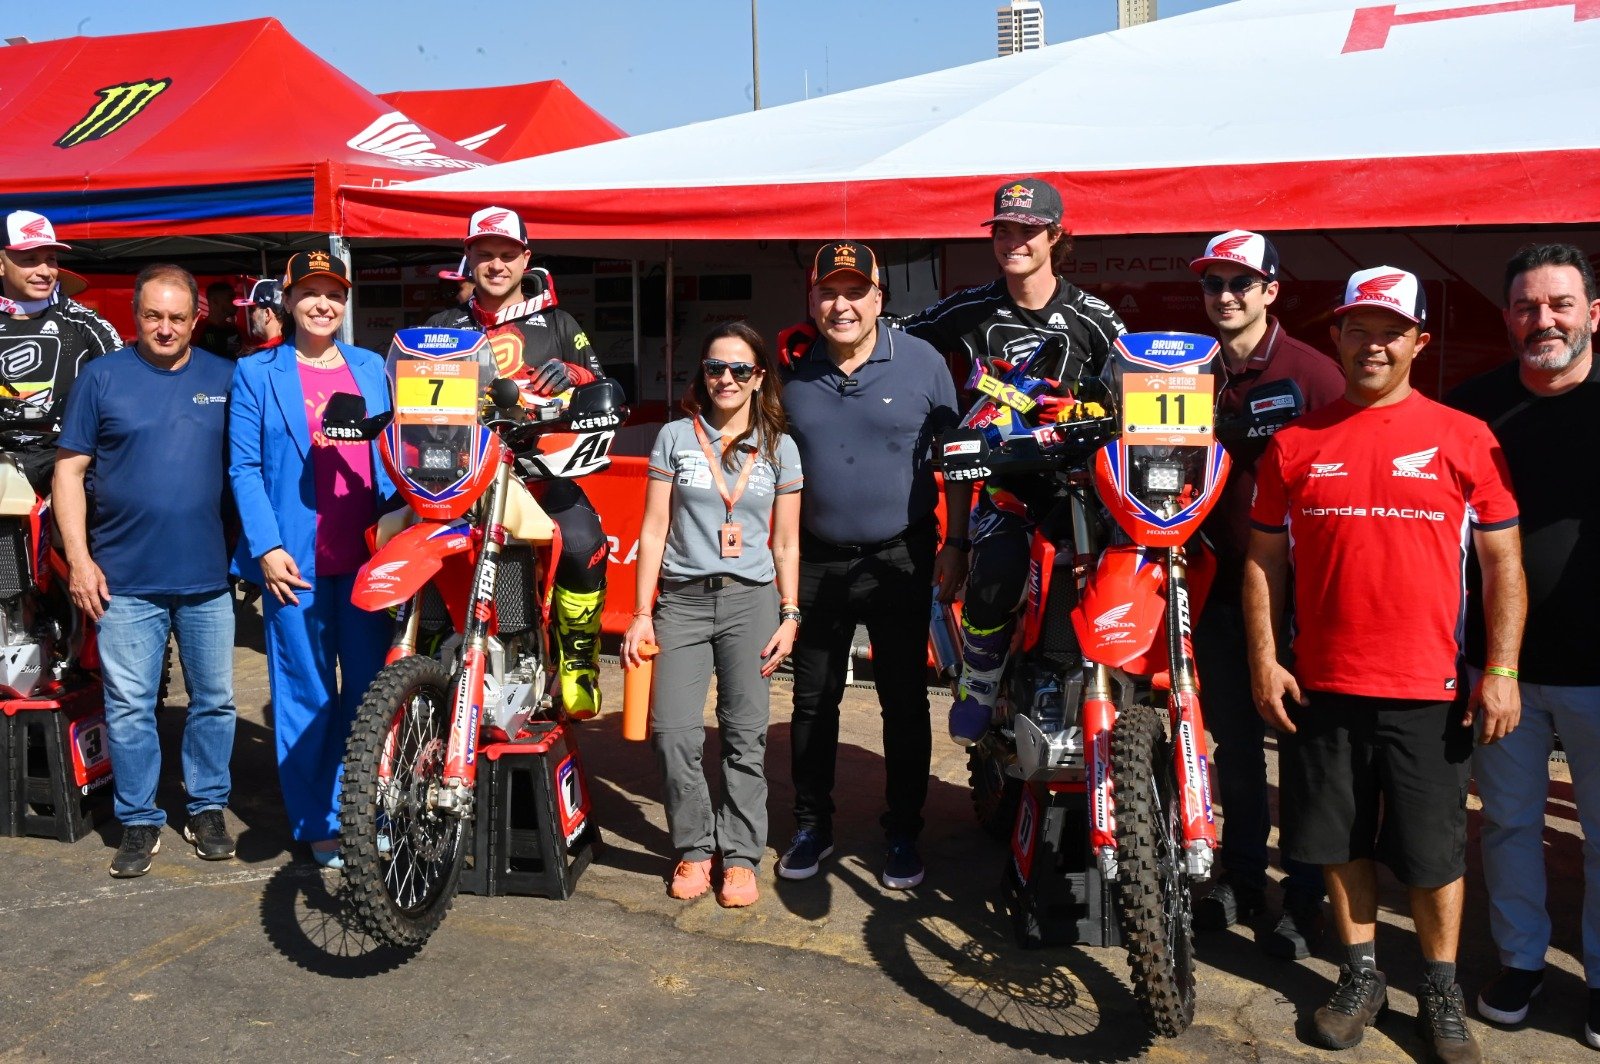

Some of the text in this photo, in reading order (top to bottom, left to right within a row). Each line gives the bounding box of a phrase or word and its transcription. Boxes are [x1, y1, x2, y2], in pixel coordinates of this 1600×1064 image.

[1014, 198, 1032, 208] Bull
[1355, 293, 1401, 307] HONDA
[424, 334, 450, 343] TIAGO
[1152, 339, 1185, 350] BRUNO
[1144, 349, 1186, 357] CRIVILIN
[428, 379, 444, 406] 7
[1155, 393, 1185, 425] 11
[570, 415, 620, 431] ACERBIS
[944, 466, 992, 481] ACERBIS
[1391, 469, 1439, 481] HONDA
[1302, 506, 1446, 521] Honda RACING
[1146, 528, 1180, 536] HONDA
[1094, 622, 1137, 633] HONDA
[468, 706, 479, 751] MICHELIN
[84, 726, 103, 759] 3
[1183, 723, 1193, 765] Honda
[84, 774, 113, 793] Polispo
[1199, 757, 1212, 806] MICHELIN
[565, 772, 576, 808] 1
[1096, 784, 1105, 828] Honda
